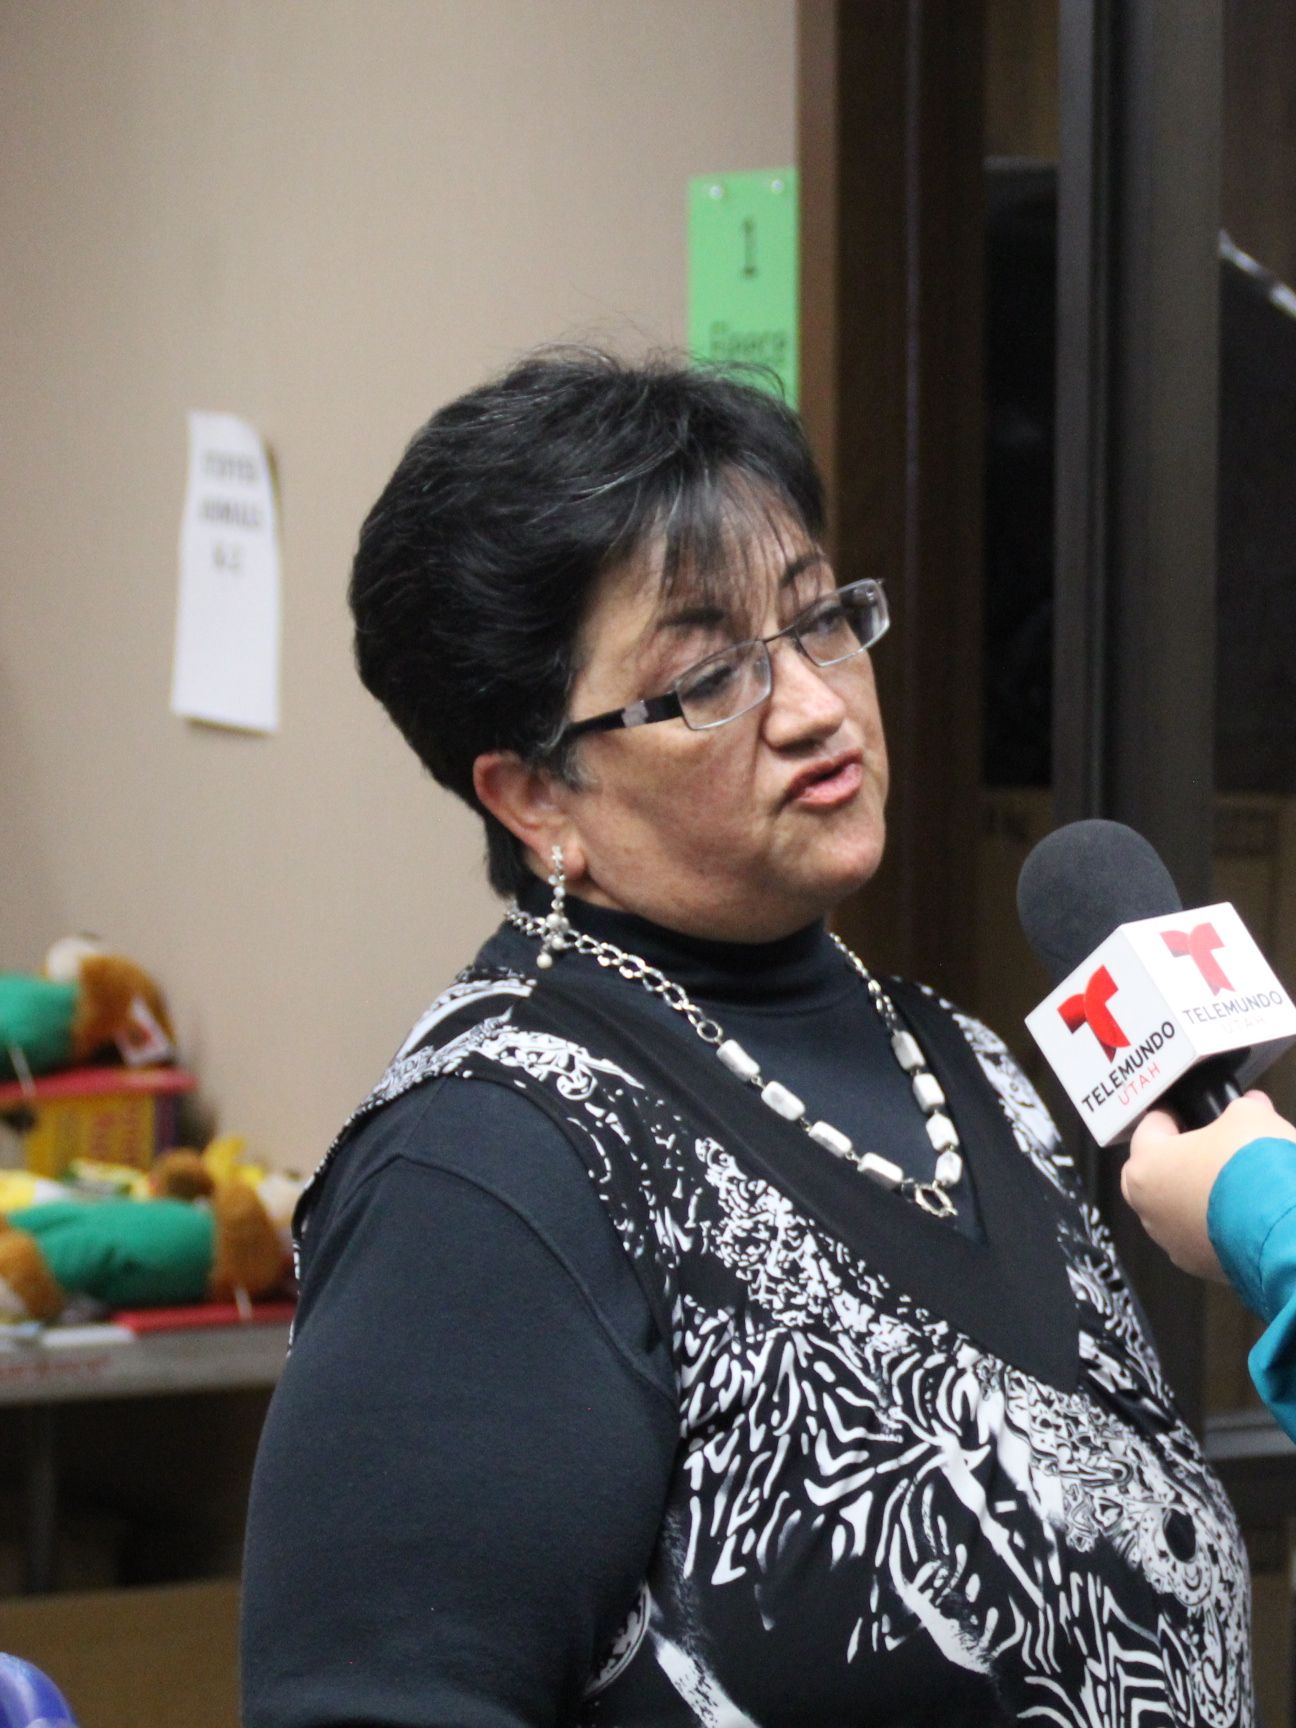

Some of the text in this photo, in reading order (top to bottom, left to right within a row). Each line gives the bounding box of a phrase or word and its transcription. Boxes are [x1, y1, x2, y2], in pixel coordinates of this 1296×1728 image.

[1182, 990, 1284, 1025] TELEMUNDO
[1220, 1016, 1266, 1034] UTAH
[1081, 1020, 1176, 1114] TELEMUNDO
[1119, 1062, 1161, 1106] UTAH
